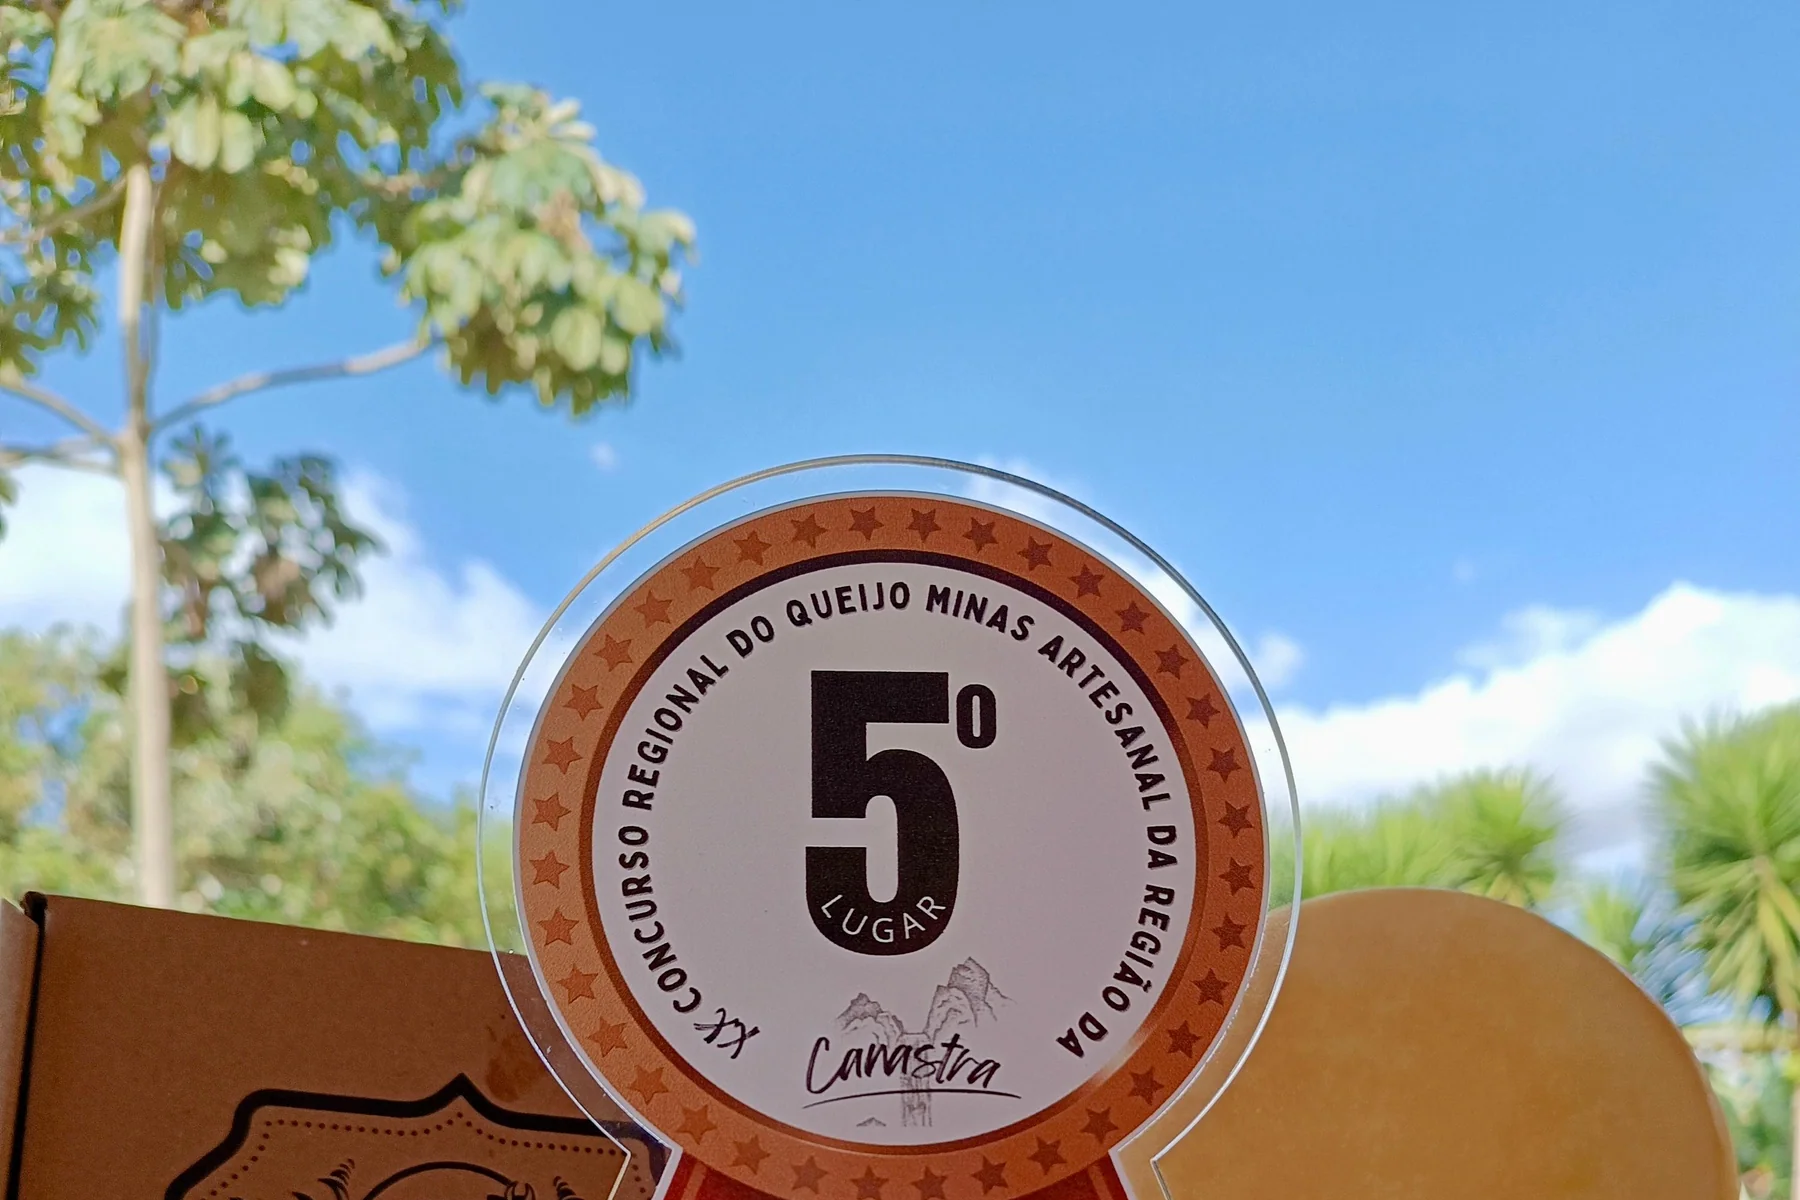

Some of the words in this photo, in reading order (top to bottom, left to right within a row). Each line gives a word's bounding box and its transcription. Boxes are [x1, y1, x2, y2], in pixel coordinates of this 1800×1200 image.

[786, 581, 911, 628] QUEIJO
[925, 584, 1036, 642] MINAS
[725, 615, 775, 659] DO
[621, 654, 730, 811] REGIONAL
[1037, 634, 1171, 811] ARTESANAL
[1146, 825, 1178, 870] DA
[617, 825, 702, 1014] CONCURSO
[821, 894, 947, 943] LUGAR
[1102, 883, 1176, 1013] REGIÃO
[805, 1033, 1002, 1094] Canastra
[1055, 1011, 1109, 1059] DA
